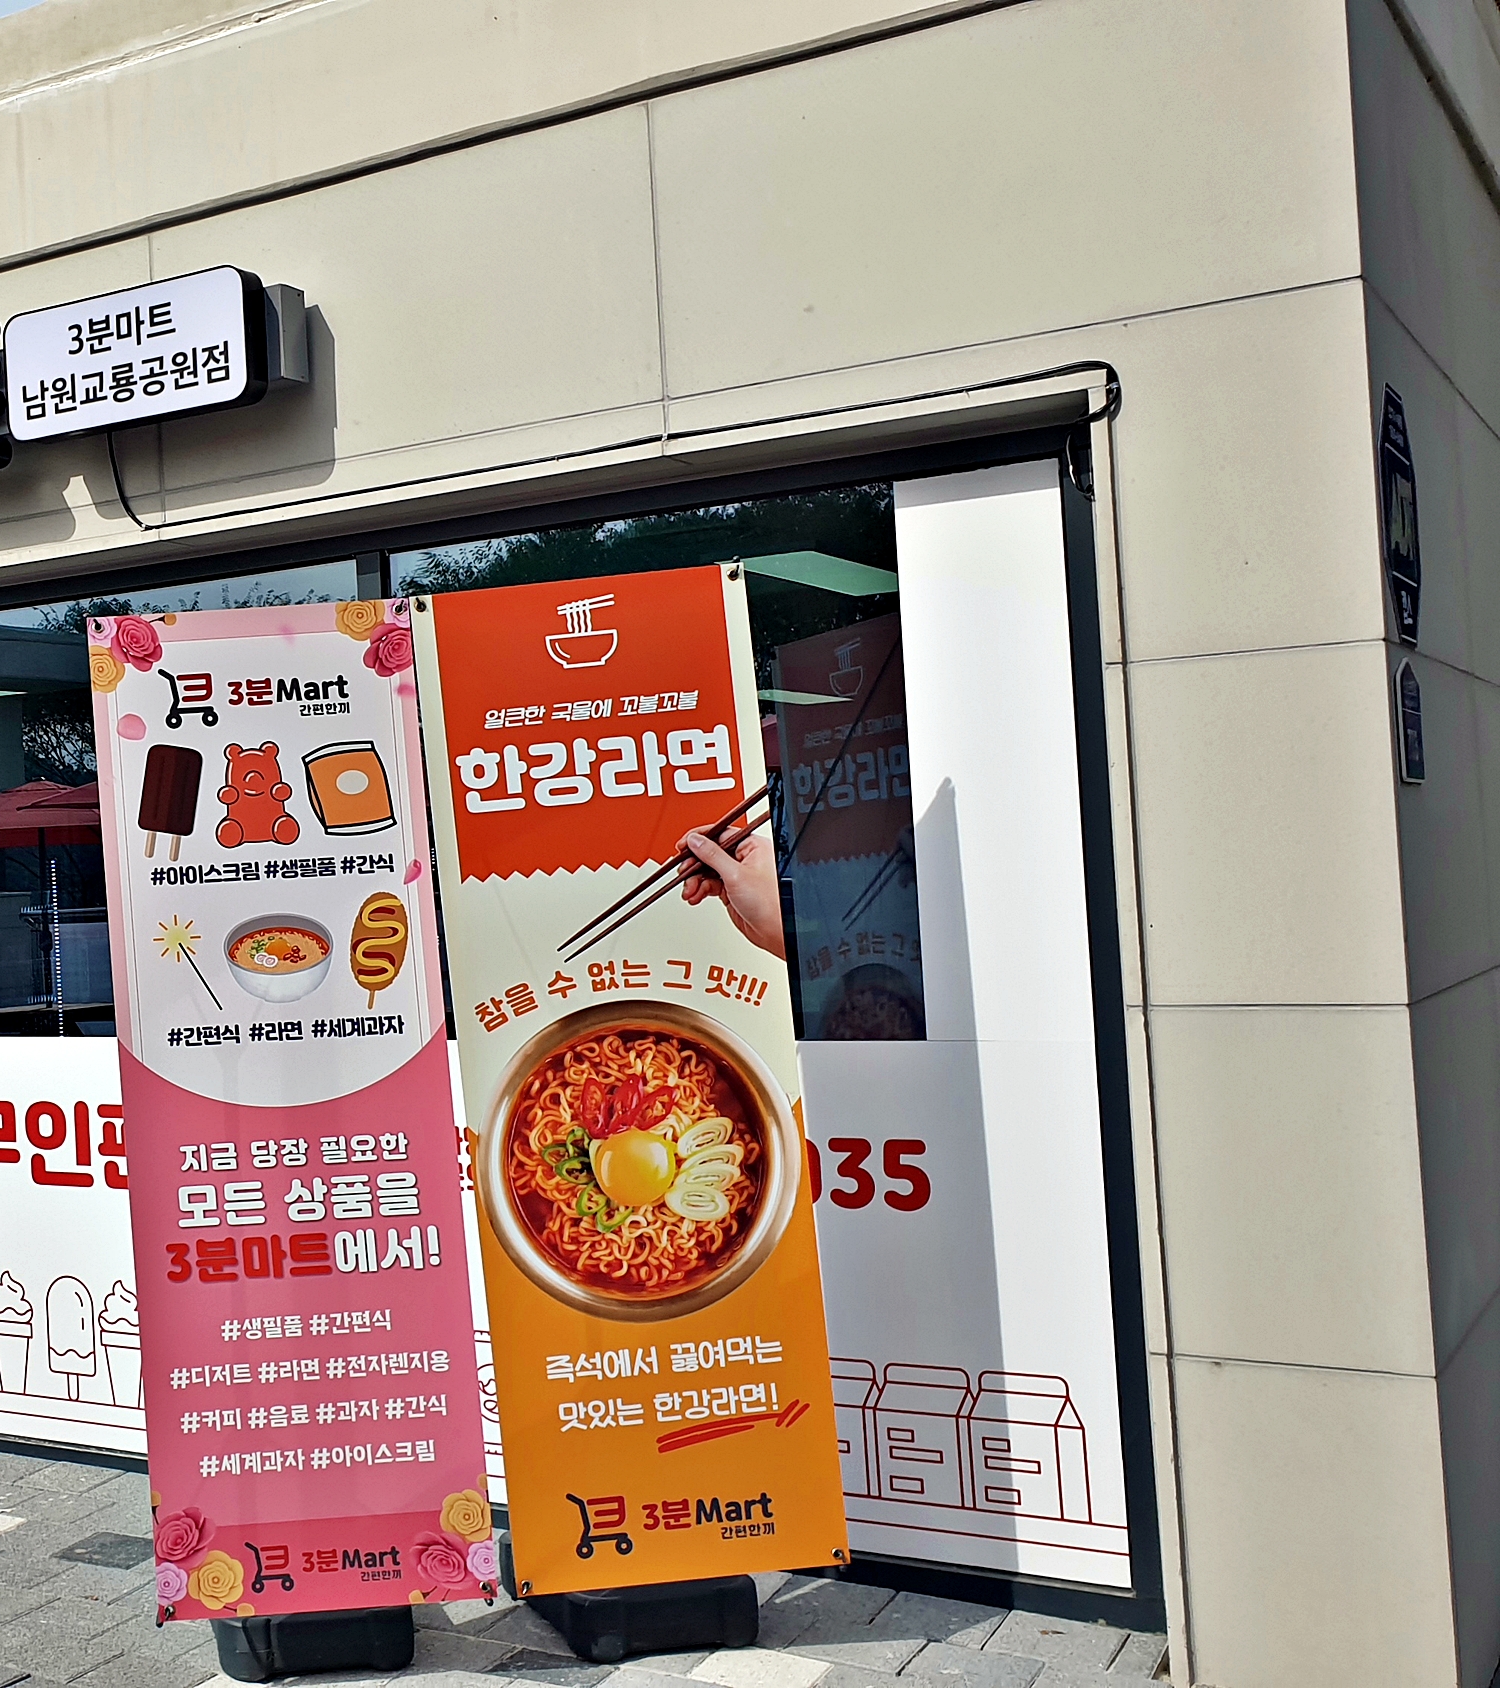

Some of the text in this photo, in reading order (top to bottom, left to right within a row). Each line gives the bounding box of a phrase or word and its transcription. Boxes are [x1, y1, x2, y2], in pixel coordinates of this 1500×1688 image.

[67, 301, 177, 355] 3분마트
[21, 341, 232, 422] 남원교룡공원점
[227, 674, 350, 706] 3분Mart
[299, 702, 351, 717] 간편한끼
[483, 690, 700, 730] 얼큰한 국물에 꼬불꼬불
[455, 724, 736, 814] 한강라면
[150, 853, 395, 885] #아이스크림 #생필품 #간식
[473, 958, 770, 1034] 참을 수 없는 그 맛!!!
[167, 1014, 405, 1048] #간편식 #라면 #세계과자
[179, 1132, 409, 1172] 지금 당장 필요한
[177, 1171, 421, 1229] 모든 상품을
[165, 1225, 442, 1283] 3분마트에서!
[220, 1309, 392, 1341] #생필품 #간편식
[170, 1350, 451, 1390] #디저트 #라면 #전자렌지용
[545, 1335, 783, 1383] 즉석에서 끓여먹는
[180, 1394, 448, 1434] #커피 #음료 #과자 #간식
[558, 1382, 780, 1433] 맛있는 한강라면!
[199, 1440, 435, 1478] #세계과자 #아이스크림
[641, 1491, 774, 1531] 3분Mart
[720, 1522, 775, 1540] 간편한끼
[301, 1545, 400, 1573] 3분Mart
[360, 1569, 402, 1582] 간편한끼
